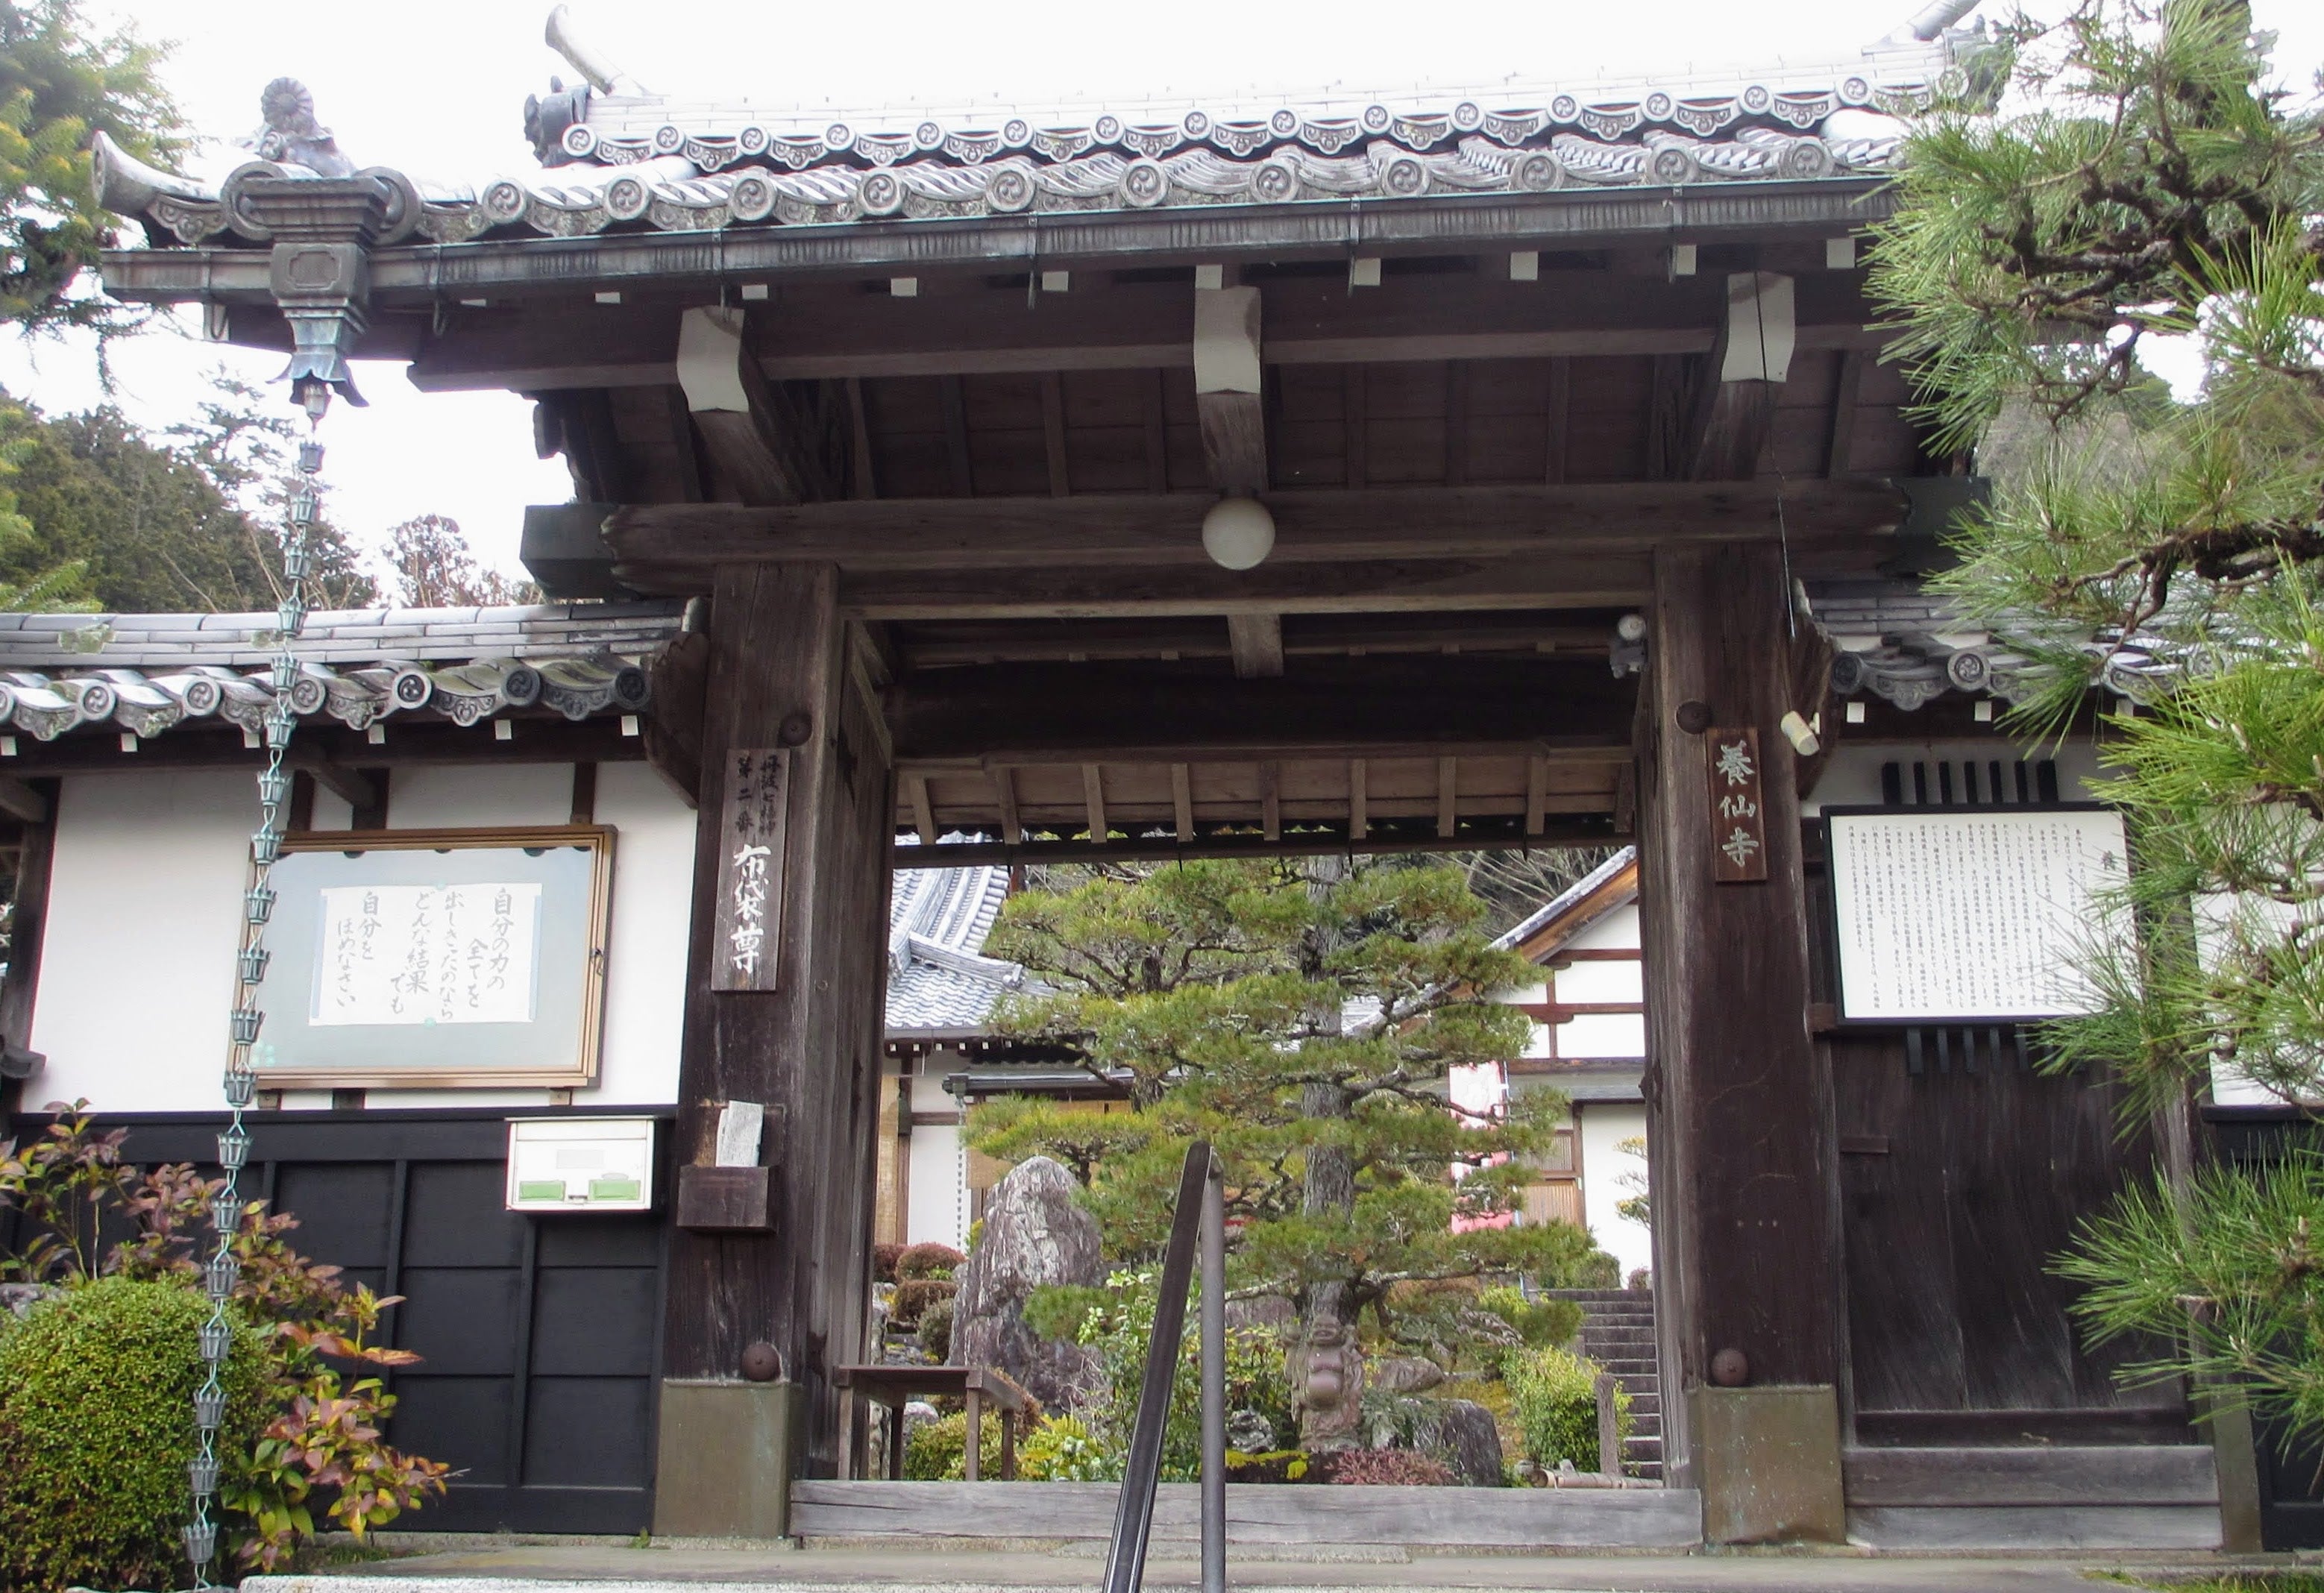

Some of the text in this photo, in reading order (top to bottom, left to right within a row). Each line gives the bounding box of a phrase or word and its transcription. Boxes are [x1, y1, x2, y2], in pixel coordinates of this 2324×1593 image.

[1715, 740, 1759, 867] 養仙寺
[358, 890, 383, 961] 自分を
[405, 890, 436, 995] どんな結果
[487, 887, 515, 990] 自分の力の
[729, 843, 772, 975] 布袋尊
[336, 917, 356, 1008] ほめなさい
[390, 973, 405, 1014] でも
[467, 937, 489, 1008] 全てを
